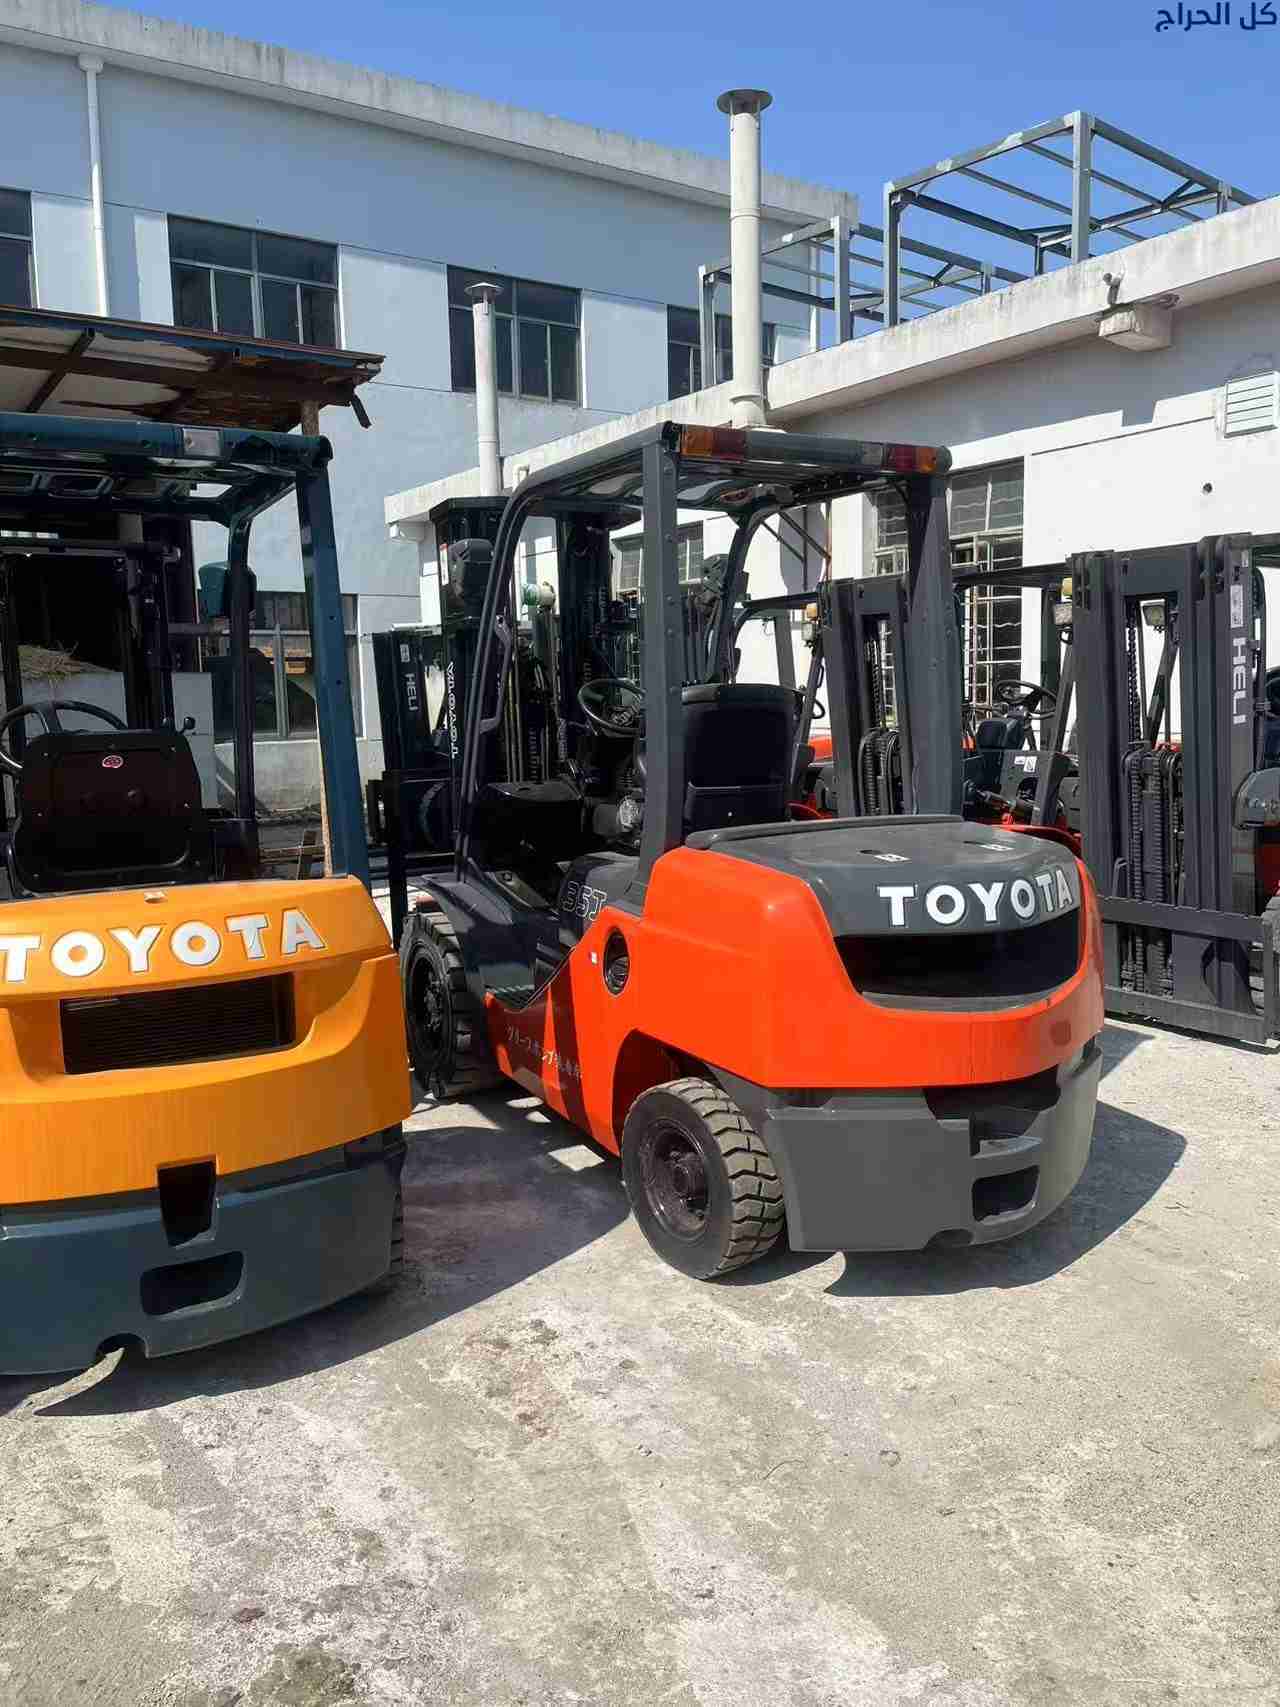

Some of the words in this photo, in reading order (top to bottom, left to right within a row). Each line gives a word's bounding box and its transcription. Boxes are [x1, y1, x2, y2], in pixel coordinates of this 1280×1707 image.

[405, 673, 418, 711] HELI
[447, 661, 459, 759] TOYOTA
[1233, 637, 1246, 725] HELI
[877, 868, 1074, 927] TOYOTA
[0, 907, 327, 983] TOYOTA
